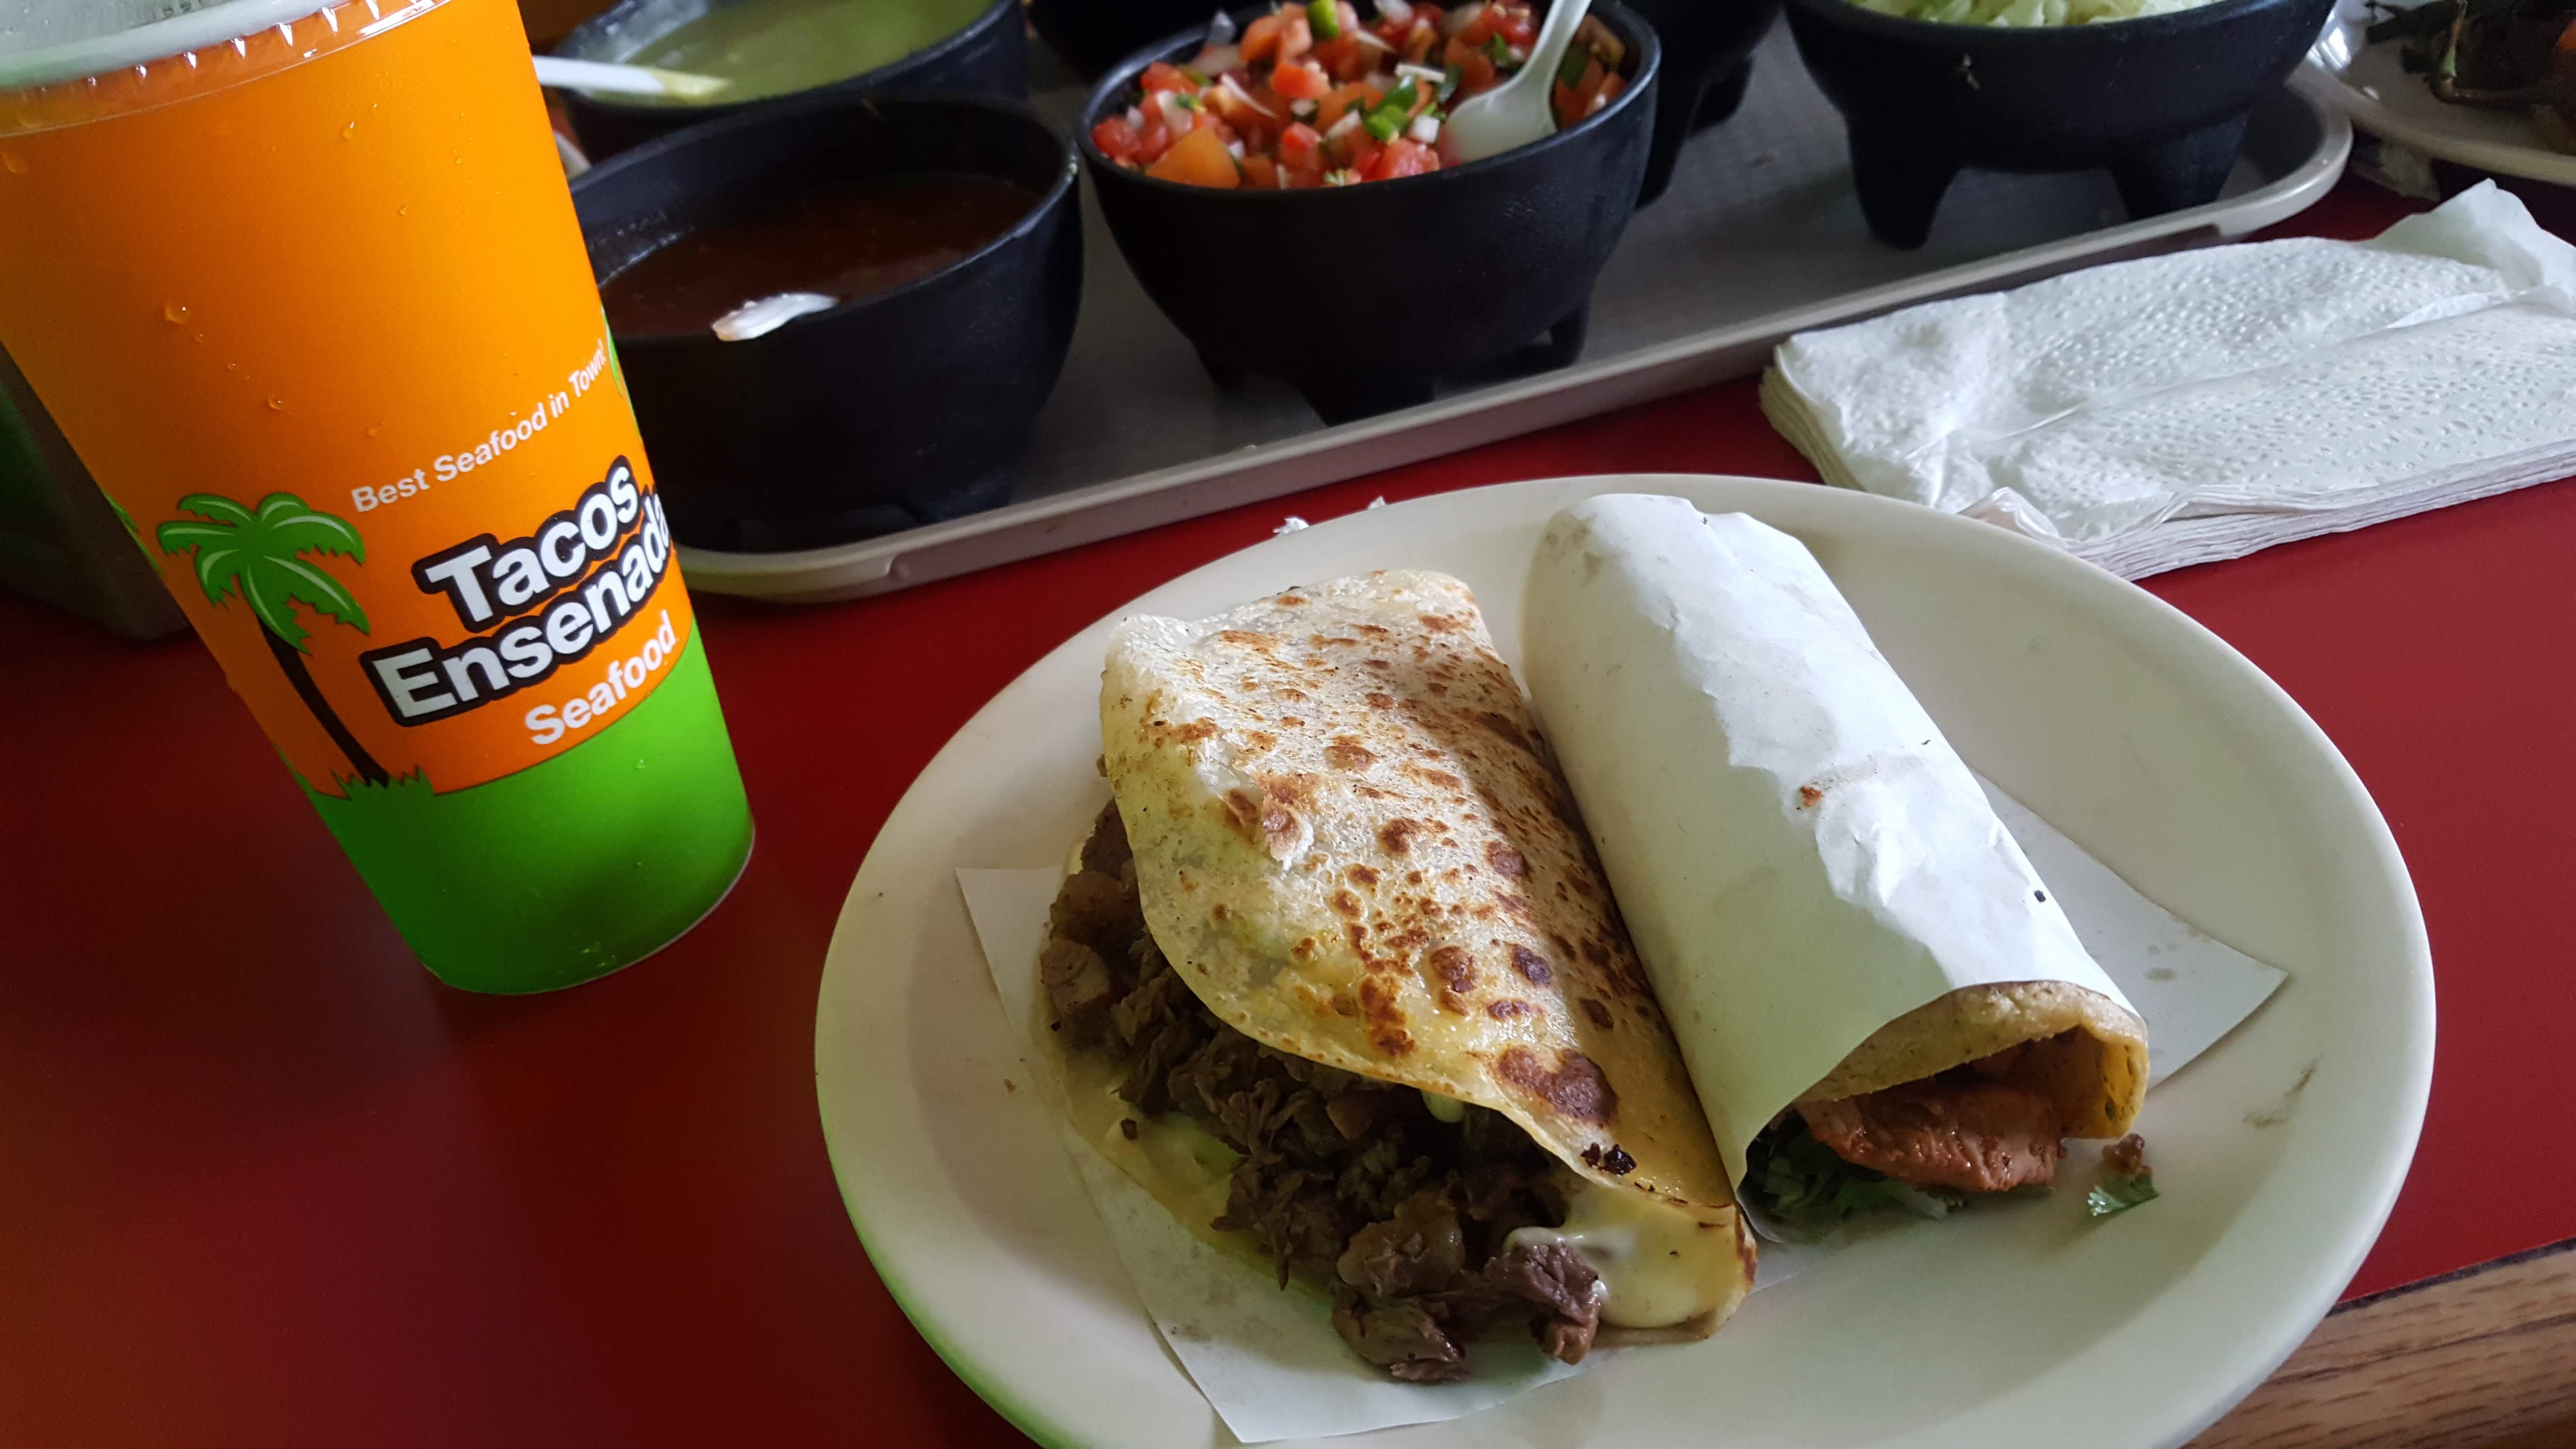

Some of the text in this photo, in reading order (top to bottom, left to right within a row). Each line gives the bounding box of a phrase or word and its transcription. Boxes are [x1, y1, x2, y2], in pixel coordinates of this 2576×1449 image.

[350, 339, 606, 513] Best Seafood in Town!
[425, 465, 639, 623] Tacos
[524, 609, 677, 745] Seafood
